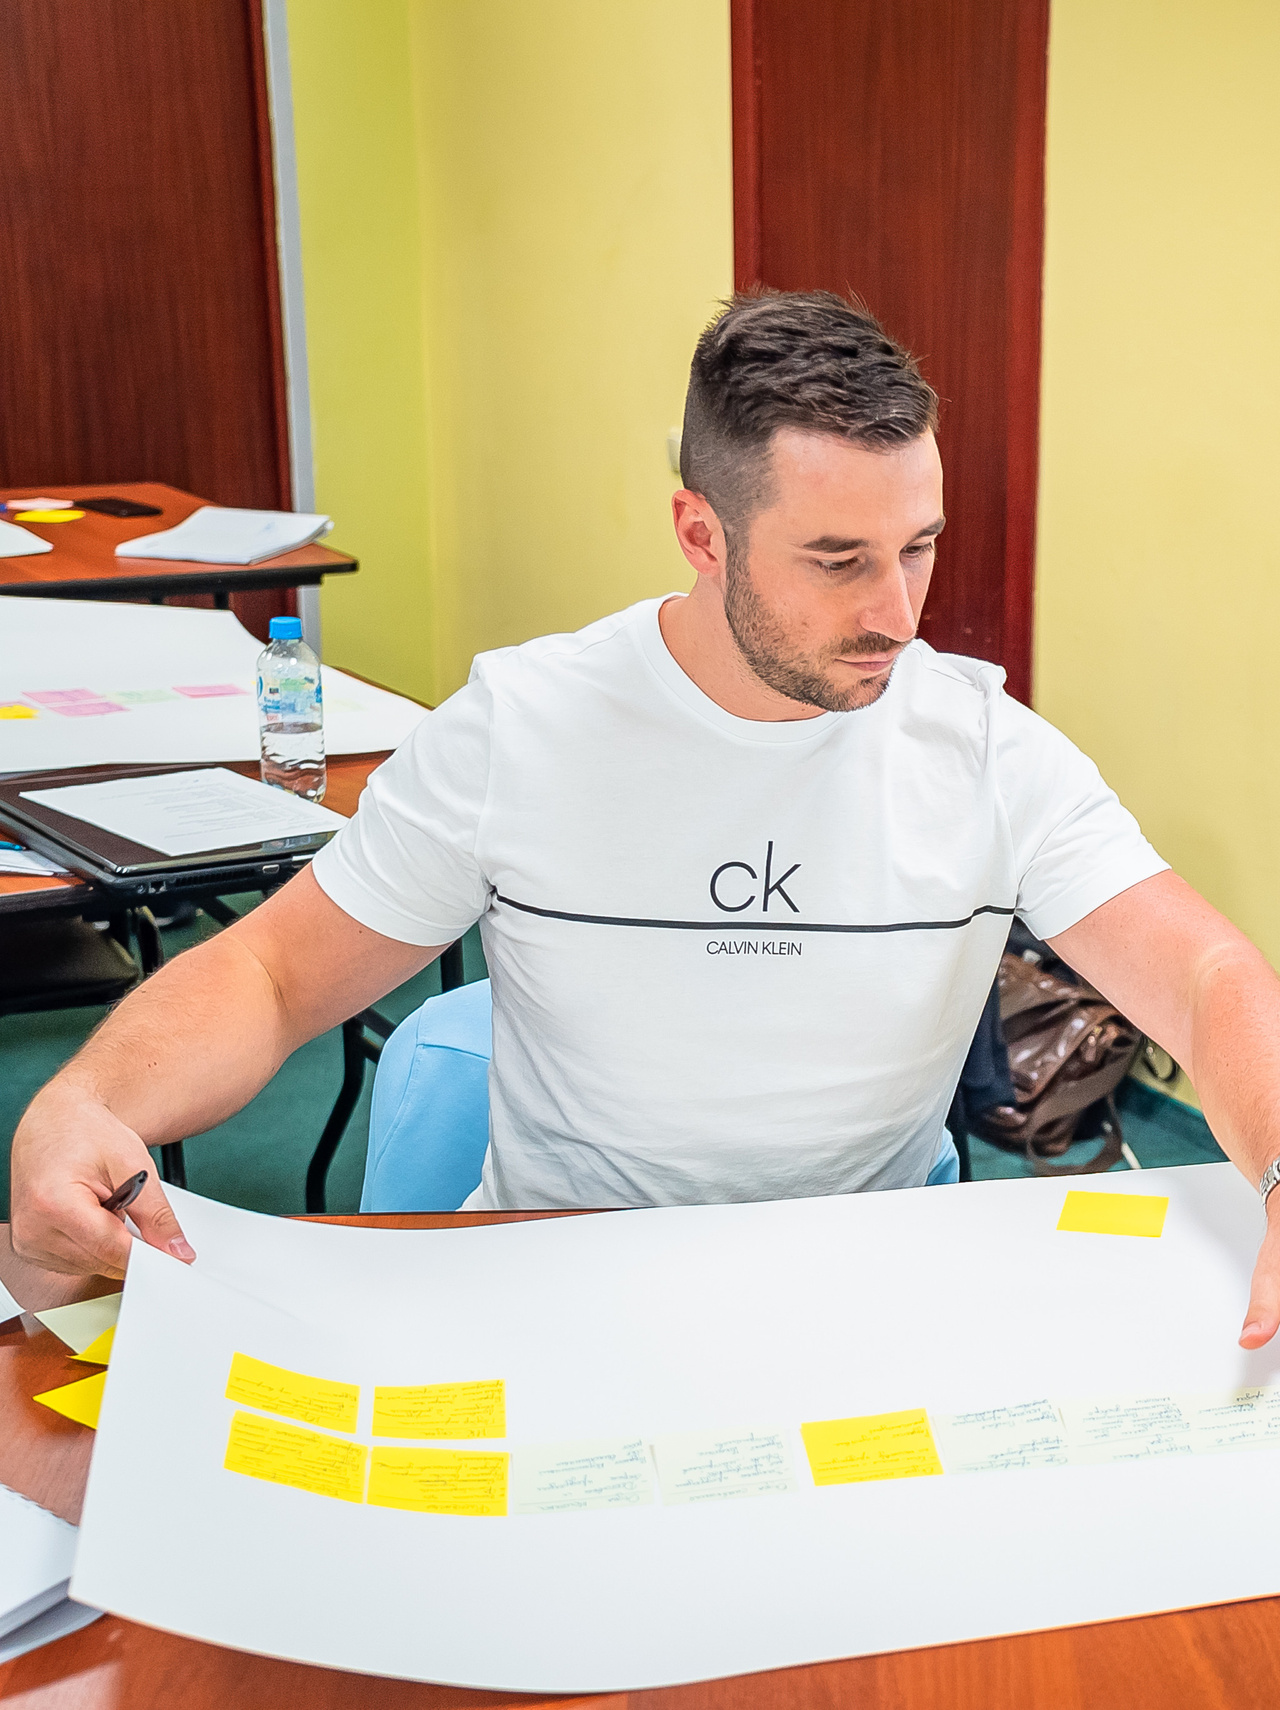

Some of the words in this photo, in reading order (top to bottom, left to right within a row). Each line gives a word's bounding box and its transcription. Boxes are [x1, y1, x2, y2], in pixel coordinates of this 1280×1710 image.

[710, 841, 802, 913] ck
[706, 941, 758, 955] CALVIN
[762, 941, 802, 956] KLEIN
